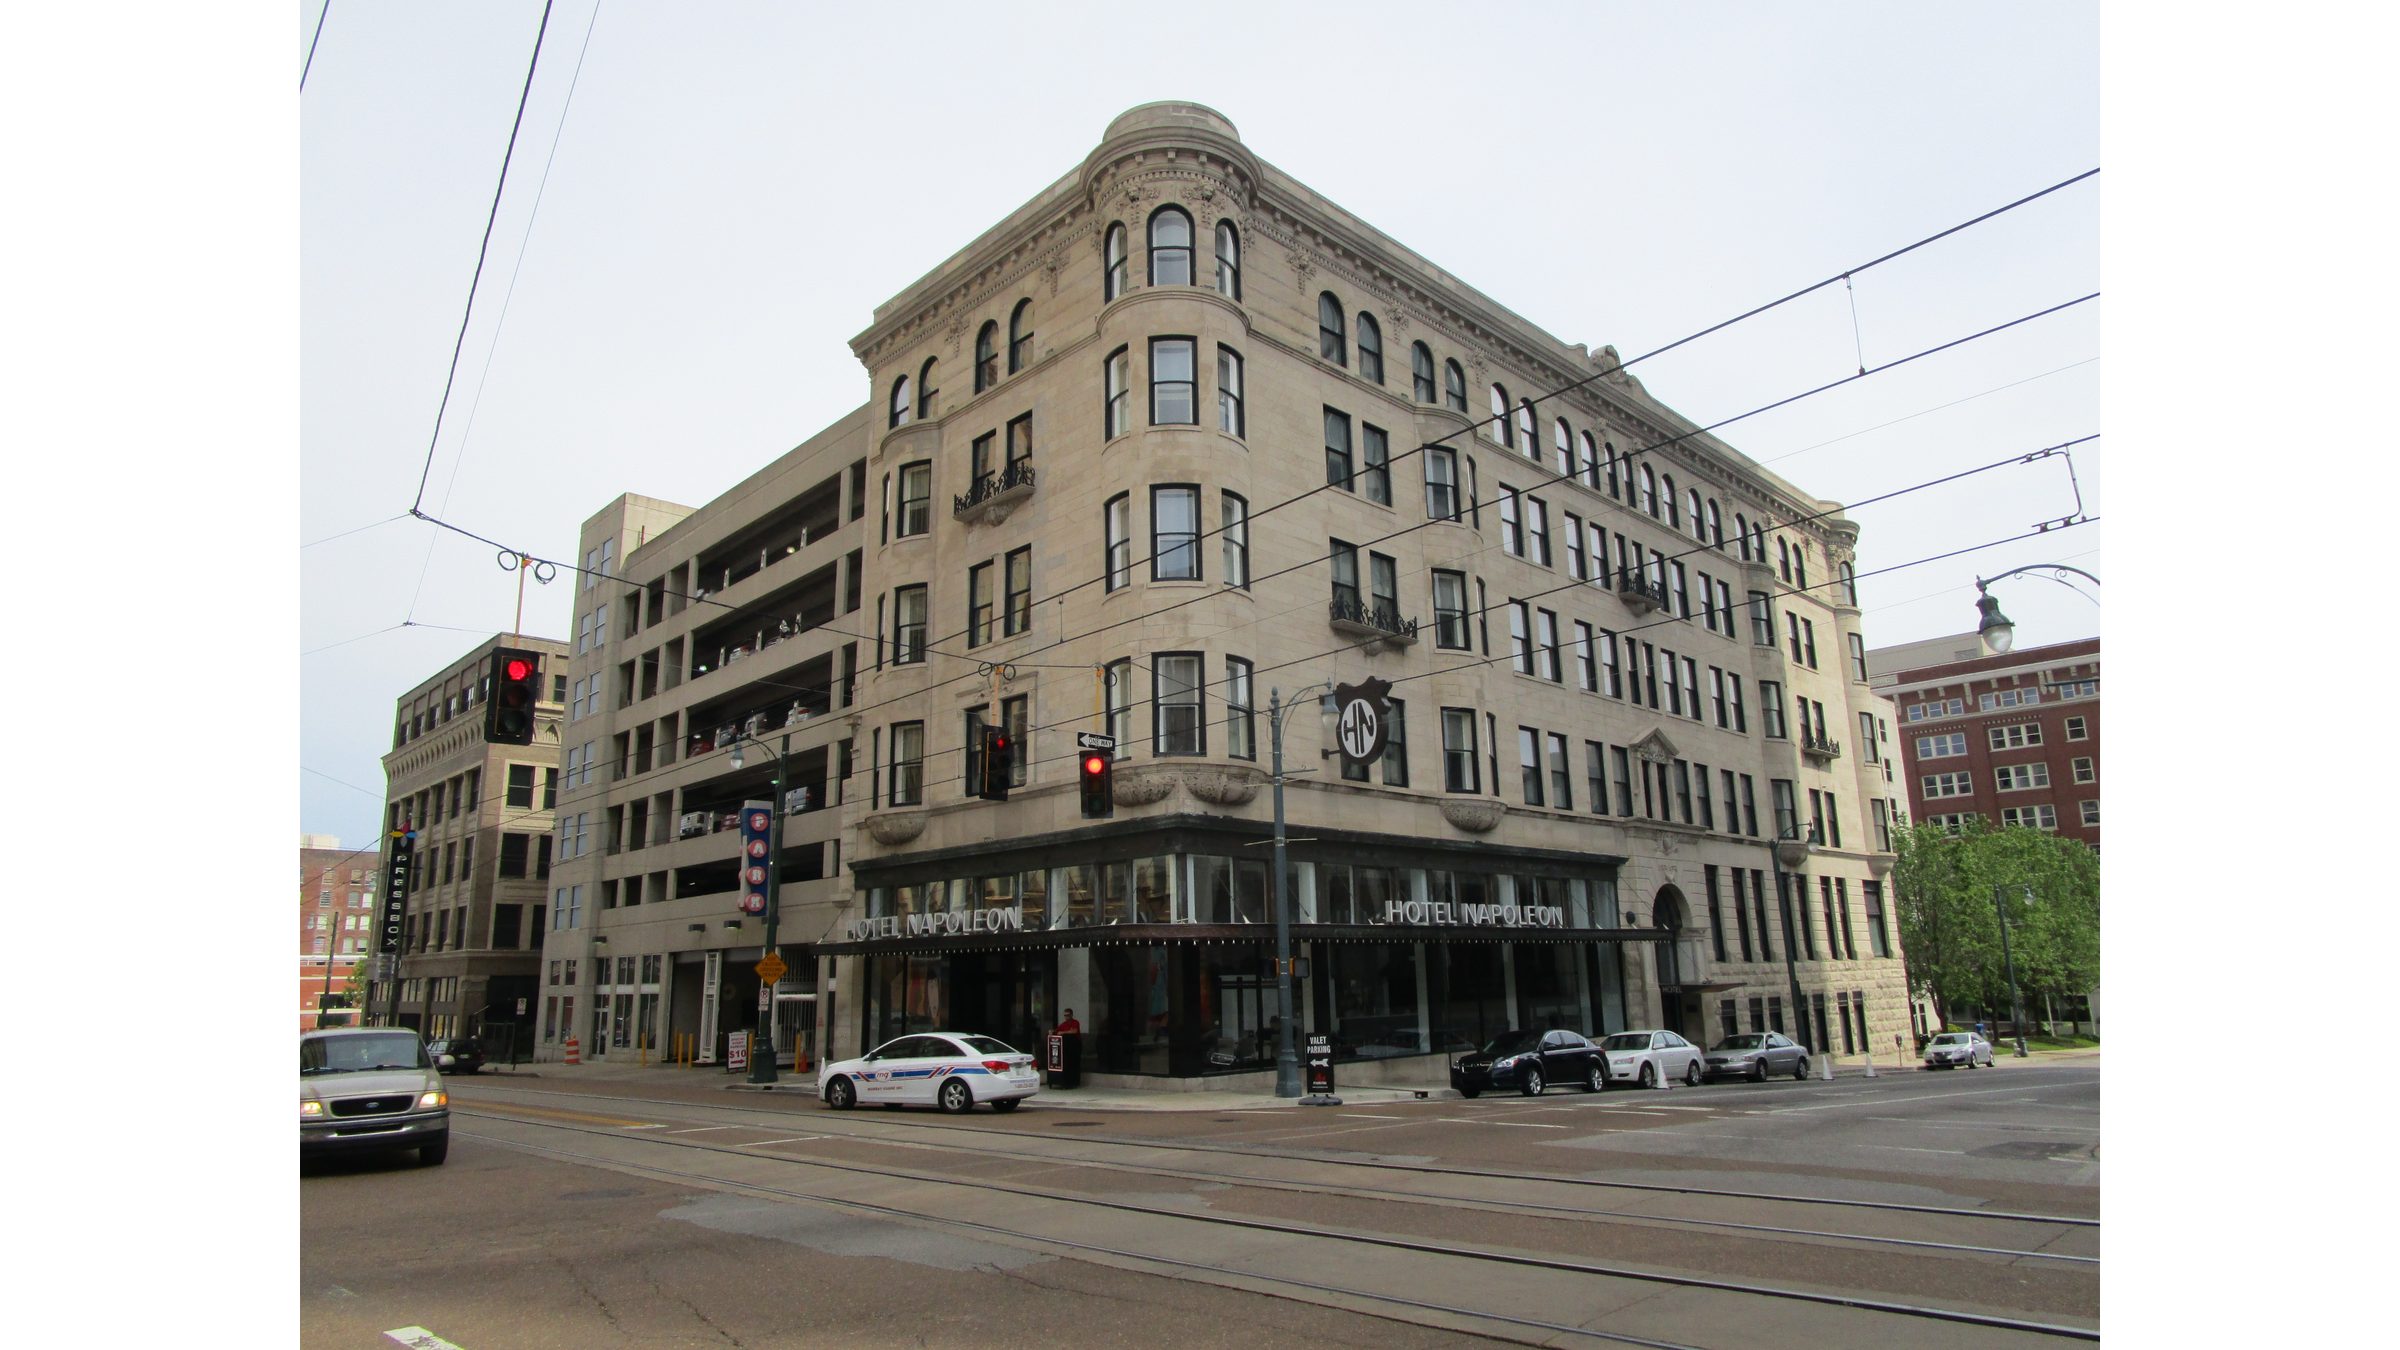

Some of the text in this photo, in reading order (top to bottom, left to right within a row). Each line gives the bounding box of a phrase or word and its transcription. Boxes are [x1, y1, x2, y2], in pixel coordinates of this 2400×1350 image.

[1343, 701, 1375, 755] HN
[1089, 736, 1113, 748] ONE WAY
[750, 815, 765, 908] PARK
[386, 855, 408, 946] PRESSBOX
[1385, 899, 1564, 926] HOTEL NAPOLEON
[846, 905, 1023, 940] HOTEL NAPOLEON
[1307, 1045, 1331, 1054] PARKING
[1309, 1036, 1327, 1045] VALET
[729, 1050, 747, 1059] $10
